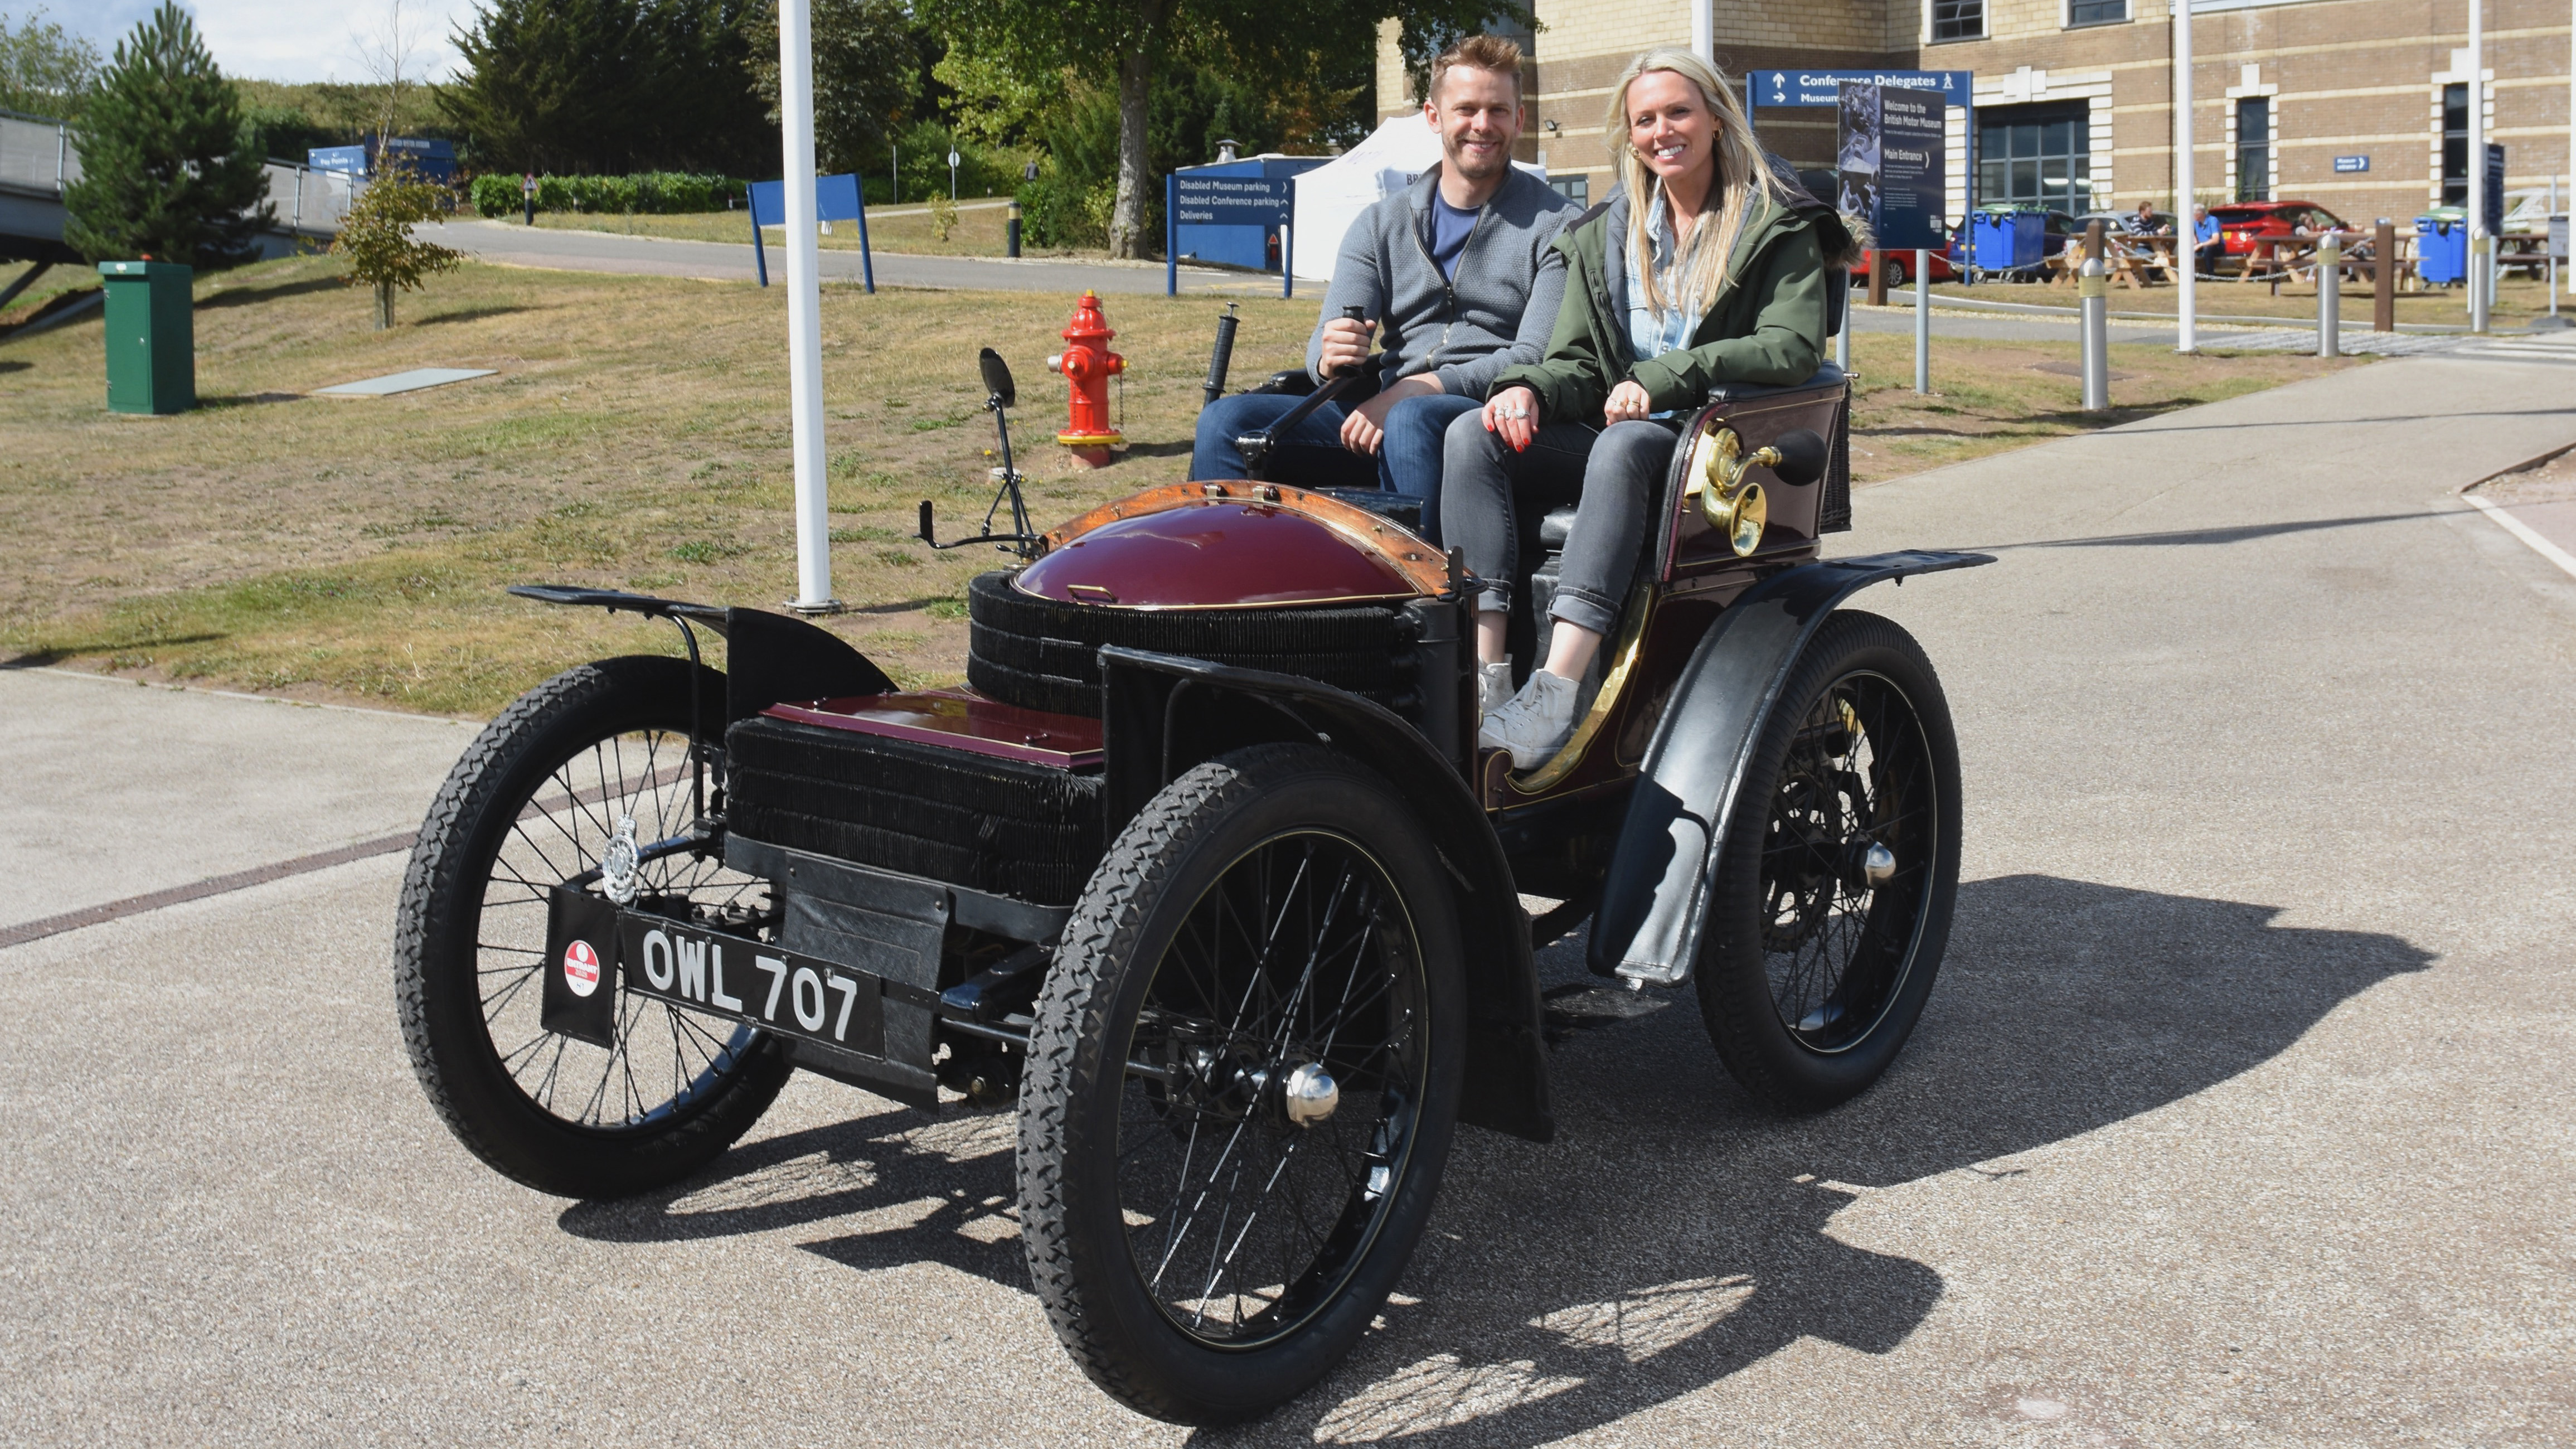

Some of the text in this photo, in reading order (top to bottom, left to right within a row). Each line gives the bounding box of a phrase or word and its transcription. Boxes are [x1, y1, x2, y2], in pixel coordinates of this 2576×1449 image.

[1875, 74, 1937, 89] Delegates
[1884, 99, 1926, 114] Welcome to the
[1884, 113, 1942, 129] British Motor Museum
[1884, 148, 1923, 161] Main Entrance
[1180, 180, 1270, 193] Disabled Museum parking
[1180, 195, 1279, 207] Disabled Conference parking
[1180, 210, 1213, 220] Deliveries
[643, 929, 857, 1041] OWL 707
